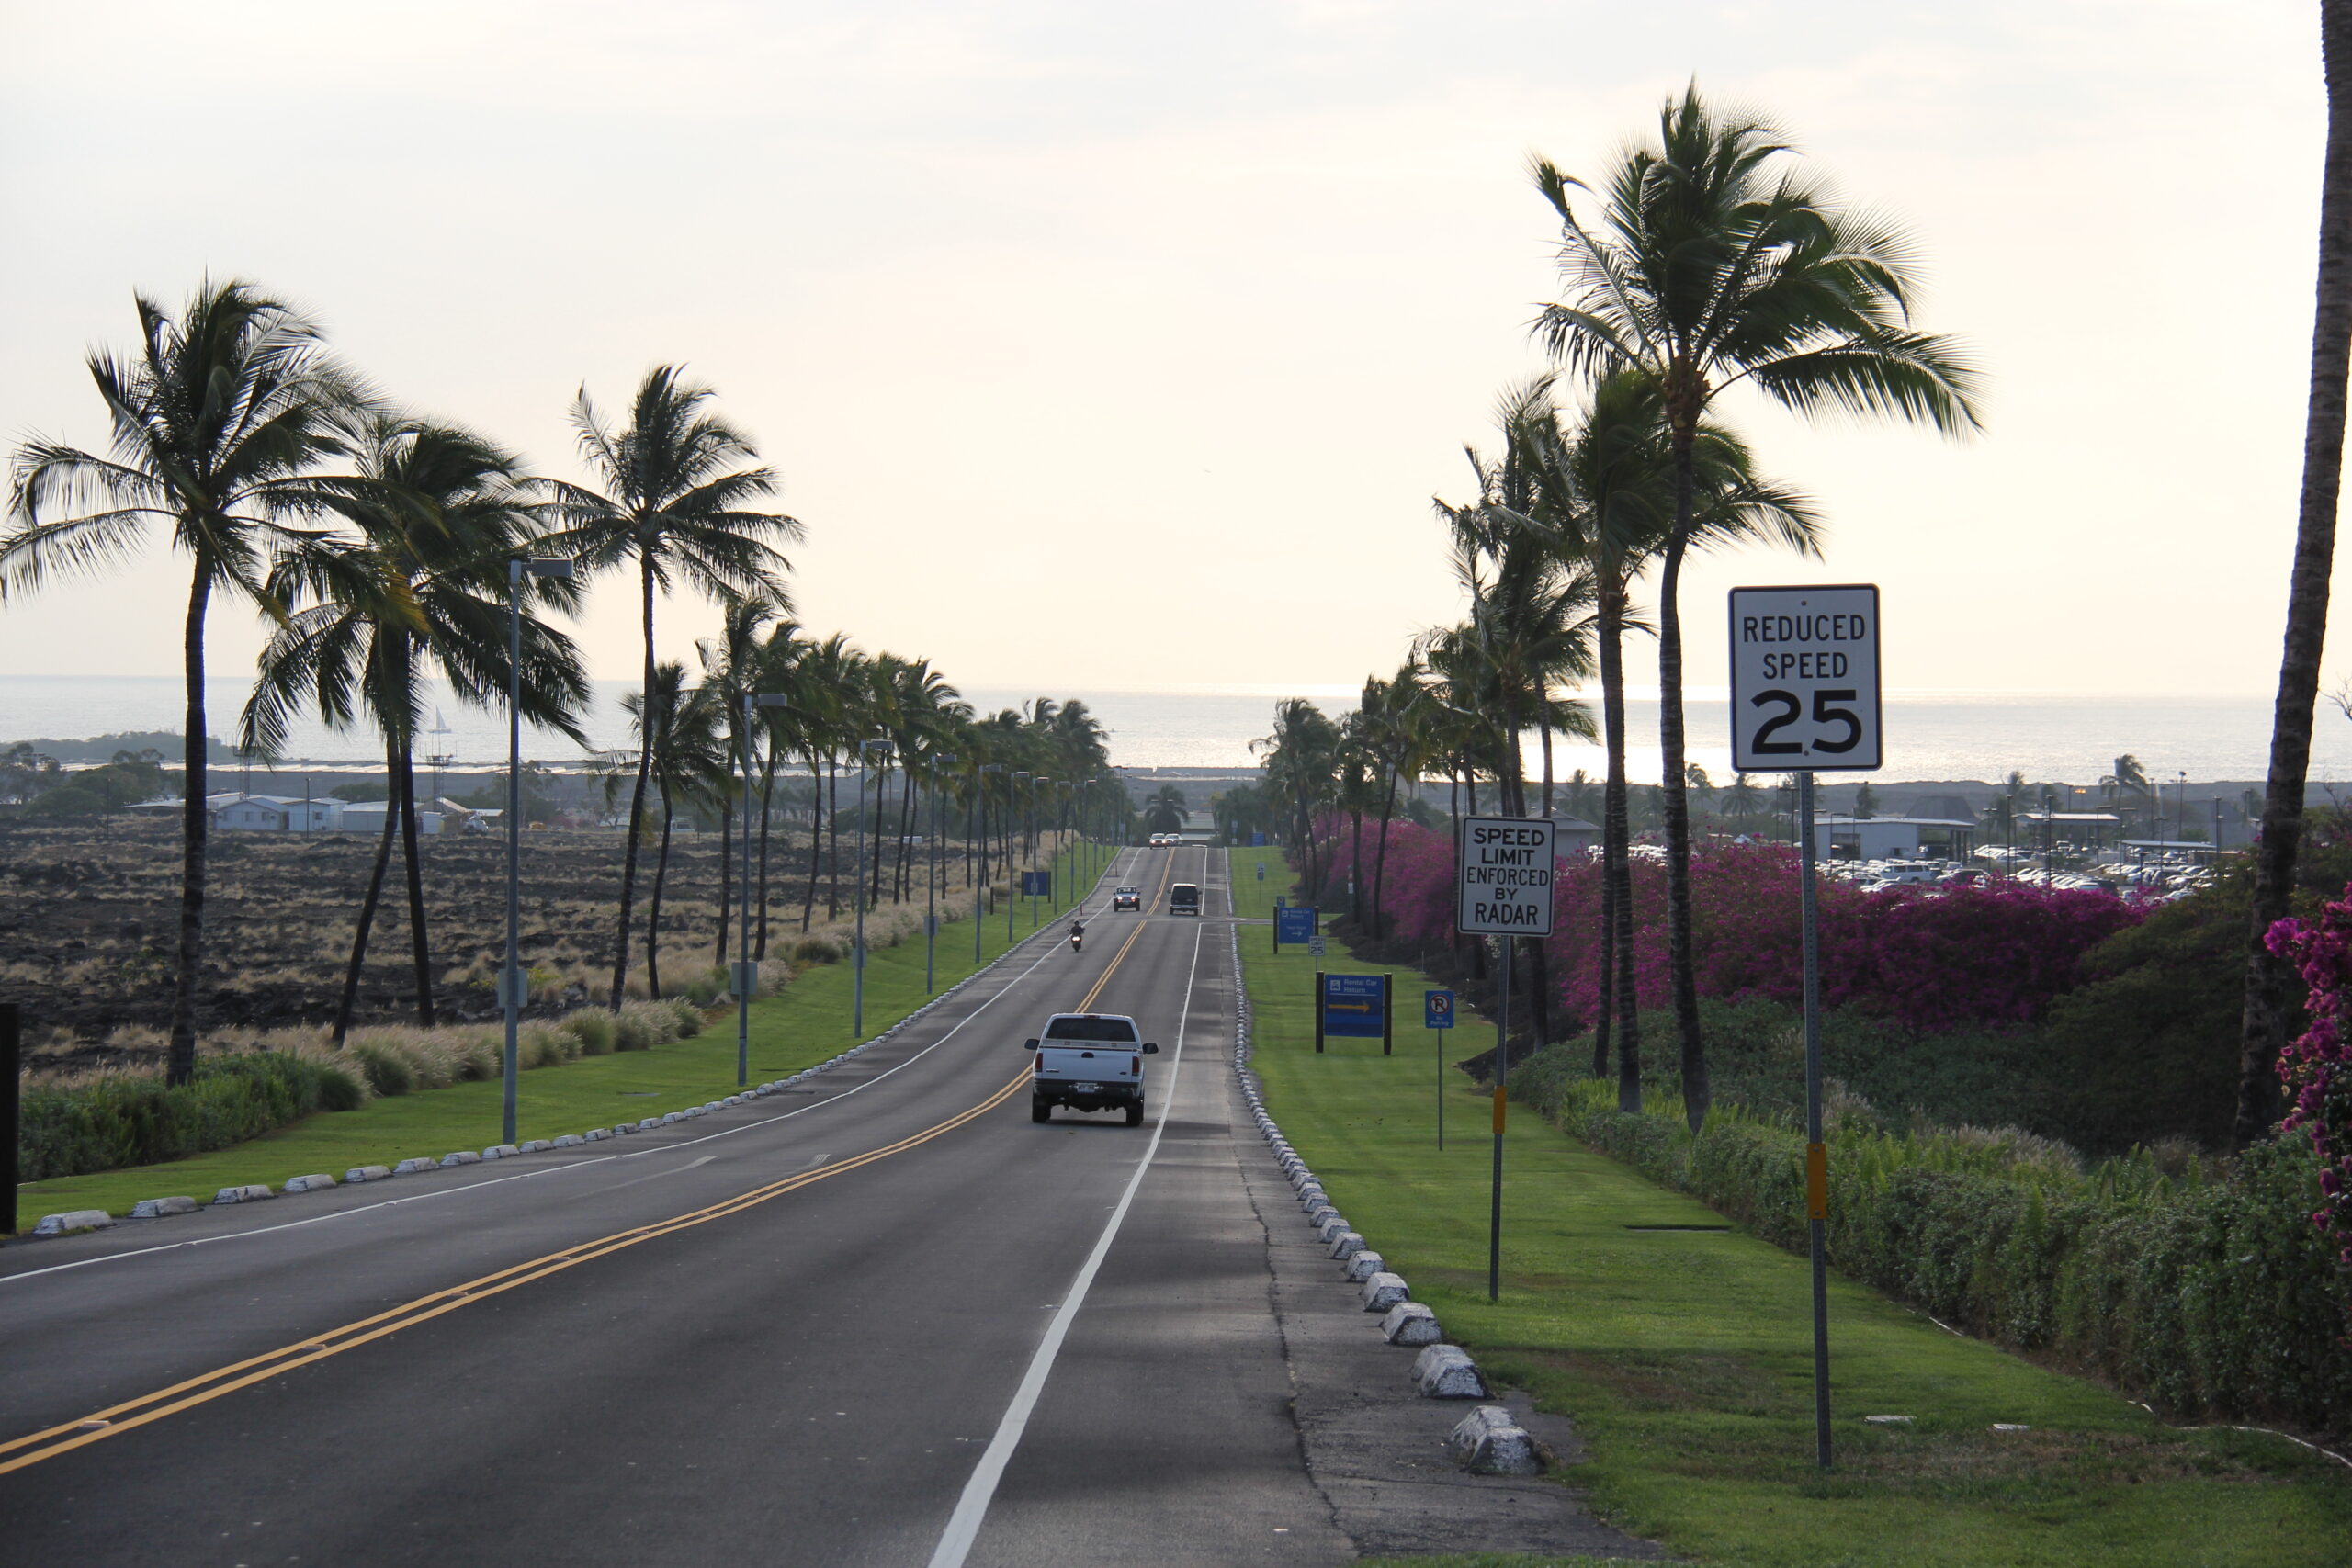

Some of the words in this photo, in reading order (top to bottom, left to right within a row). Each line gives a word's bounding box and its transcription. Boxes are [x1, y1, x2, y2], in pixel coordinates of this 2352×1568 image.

[1743, 614, 1865, 642] REDUCED
[1763, 652, 1847, 679] SPEED
[1750, 689, 1862, 755] 25
[1473, 827, 1545, 846] SPEED
[1481, 848, 1535, 866] LIMIT
[1467, 867, 1548, 886] ENFORCED
[1495, 888, 1518, 901] BY
[1475, 902, 1538, 925] RADAR
[1310, 946, 1324, 954] 25
